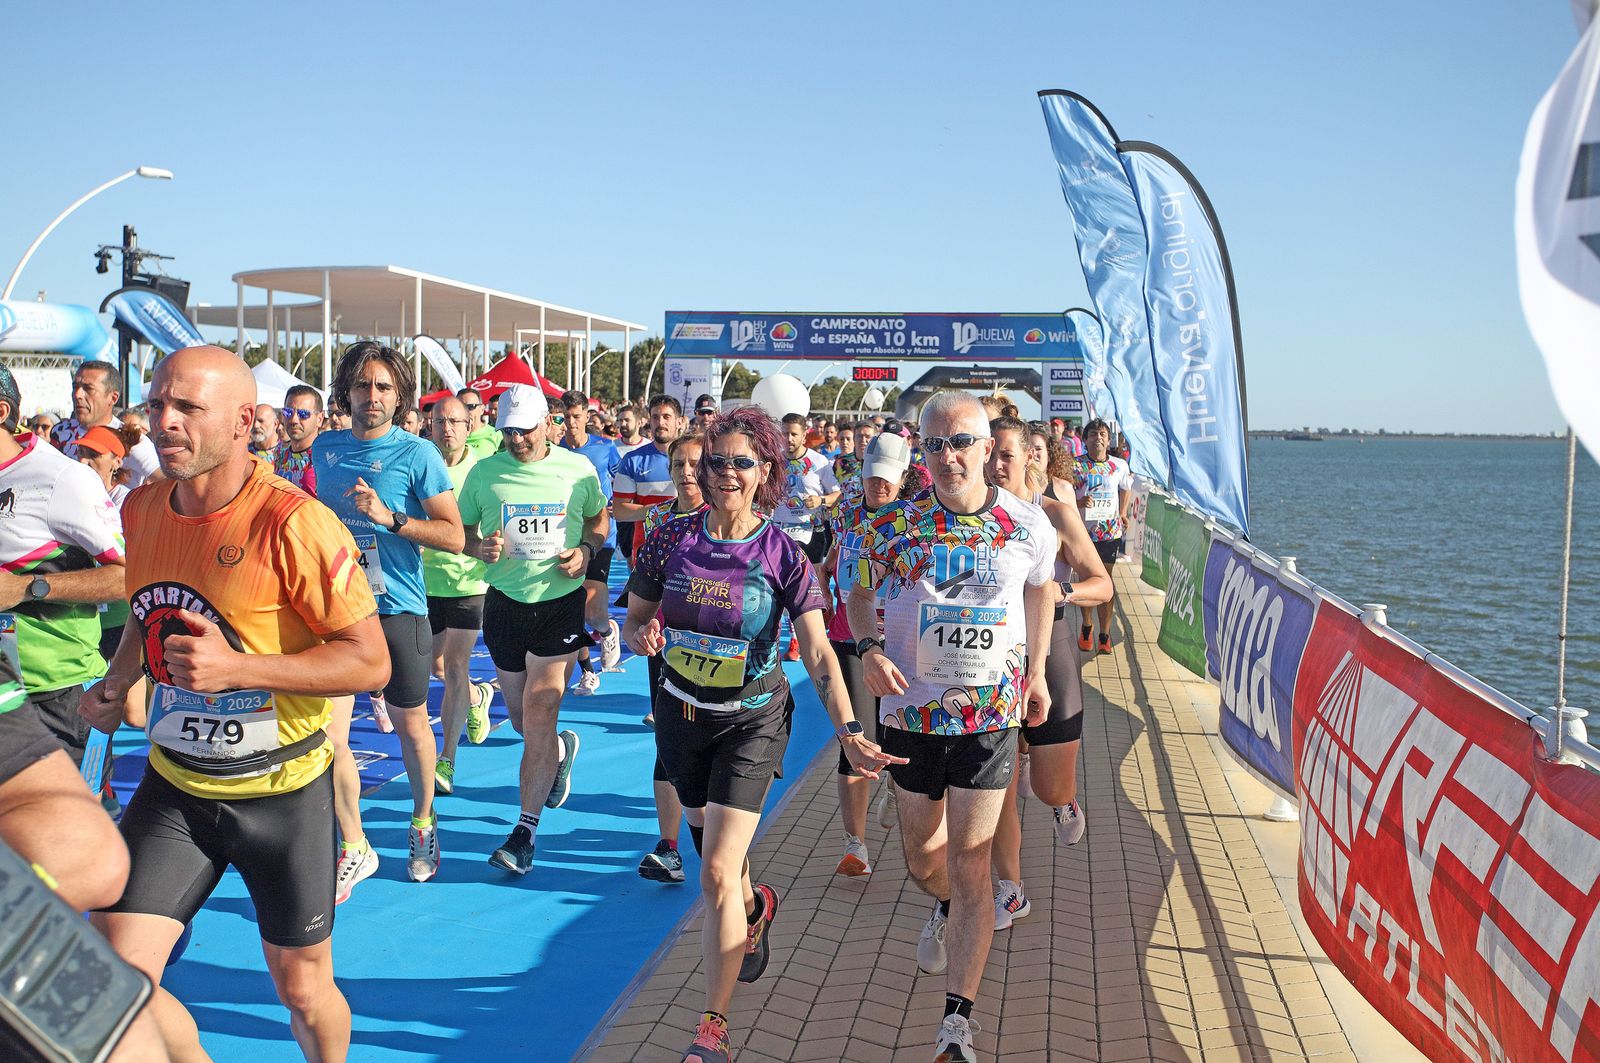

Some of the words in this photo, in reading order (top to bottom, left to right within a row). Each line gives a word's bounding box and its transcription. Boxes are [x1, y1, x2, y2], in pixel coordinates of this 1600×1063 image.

[811, 318, 906, 330] CAMPEONATO
[810, 333, 826, 344] de
[828, 332, 876, 345] ESPAÑA
[884, 331, 906, 347] 10
[911, 330, 940, 347] km
[977, 328, 1015, 341] HUELVA
[1047, 330, 1076, 343] WiH
[906, 348, 912, 356] y
[914, 347, 940, 355] Master
[543, 506, 560, 514] 2023
[518, 518, 549, 534] 811
[692, 576, 731, 589] CONSIGUE
[690, 582, 729, 599] VIVIR
[939, 610, 958, 618] HUELVA
[978, 612, 1001, 622] 2023
[934, 625, 994, 650] 1429
[714, 642, 739, 655] 2023
[680, 650, 723, 678] 777
[938, 659, 959, 667] OCHOA
[176, 695, 202, 706] HUELVA
[227, 695, 262, 711] 2023
[179, 717, 244, 745] 579
[192, 745, 236, 756] FERNANDO
